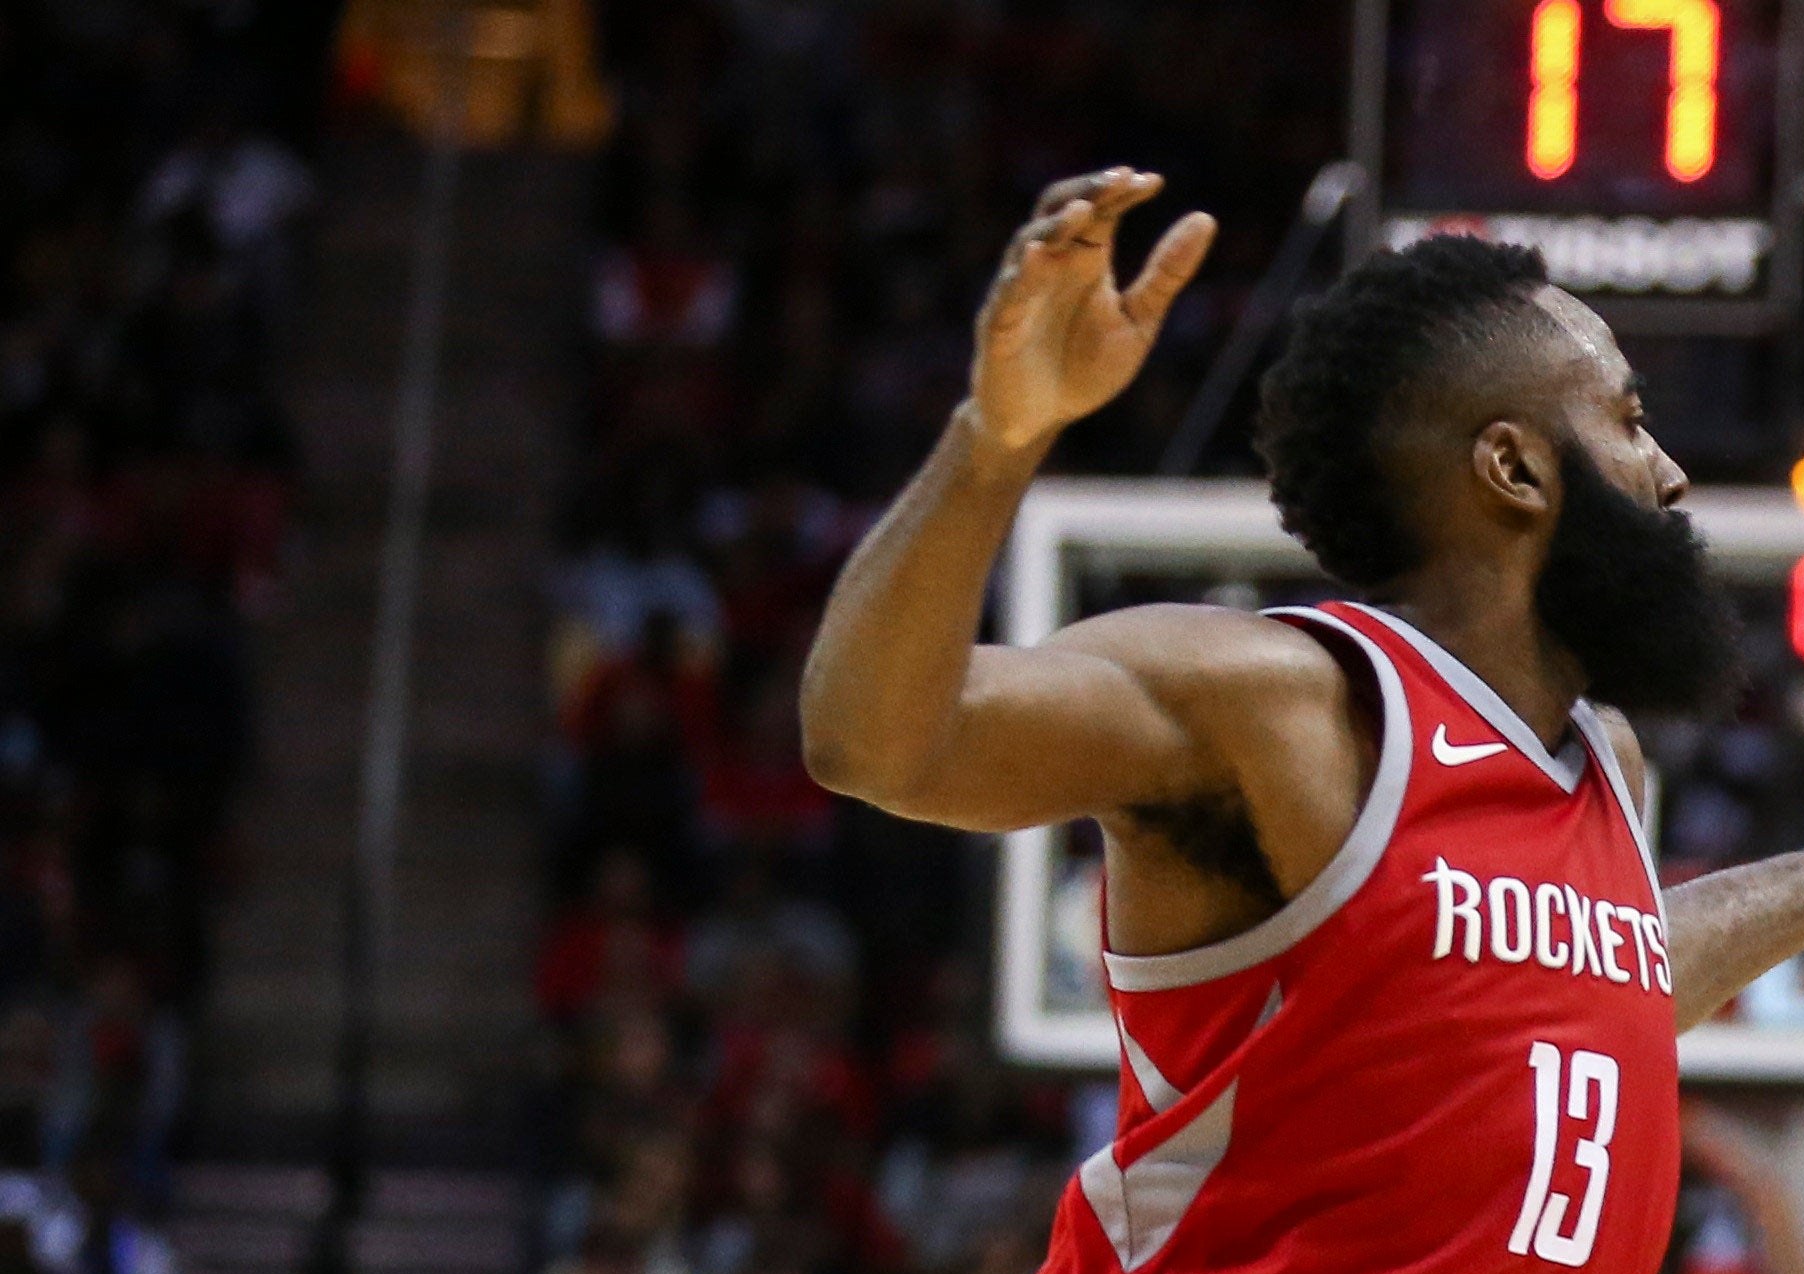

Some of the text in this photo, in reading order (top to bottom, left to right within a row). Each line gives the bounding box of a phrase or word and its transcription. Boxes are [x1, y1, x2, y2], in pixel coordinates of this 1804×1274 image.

[1528, 0, 1720, 181] 17
[1421, 856, 1674, 996] ROCKETS
[1508, 1041, 1620, 1267] 13
